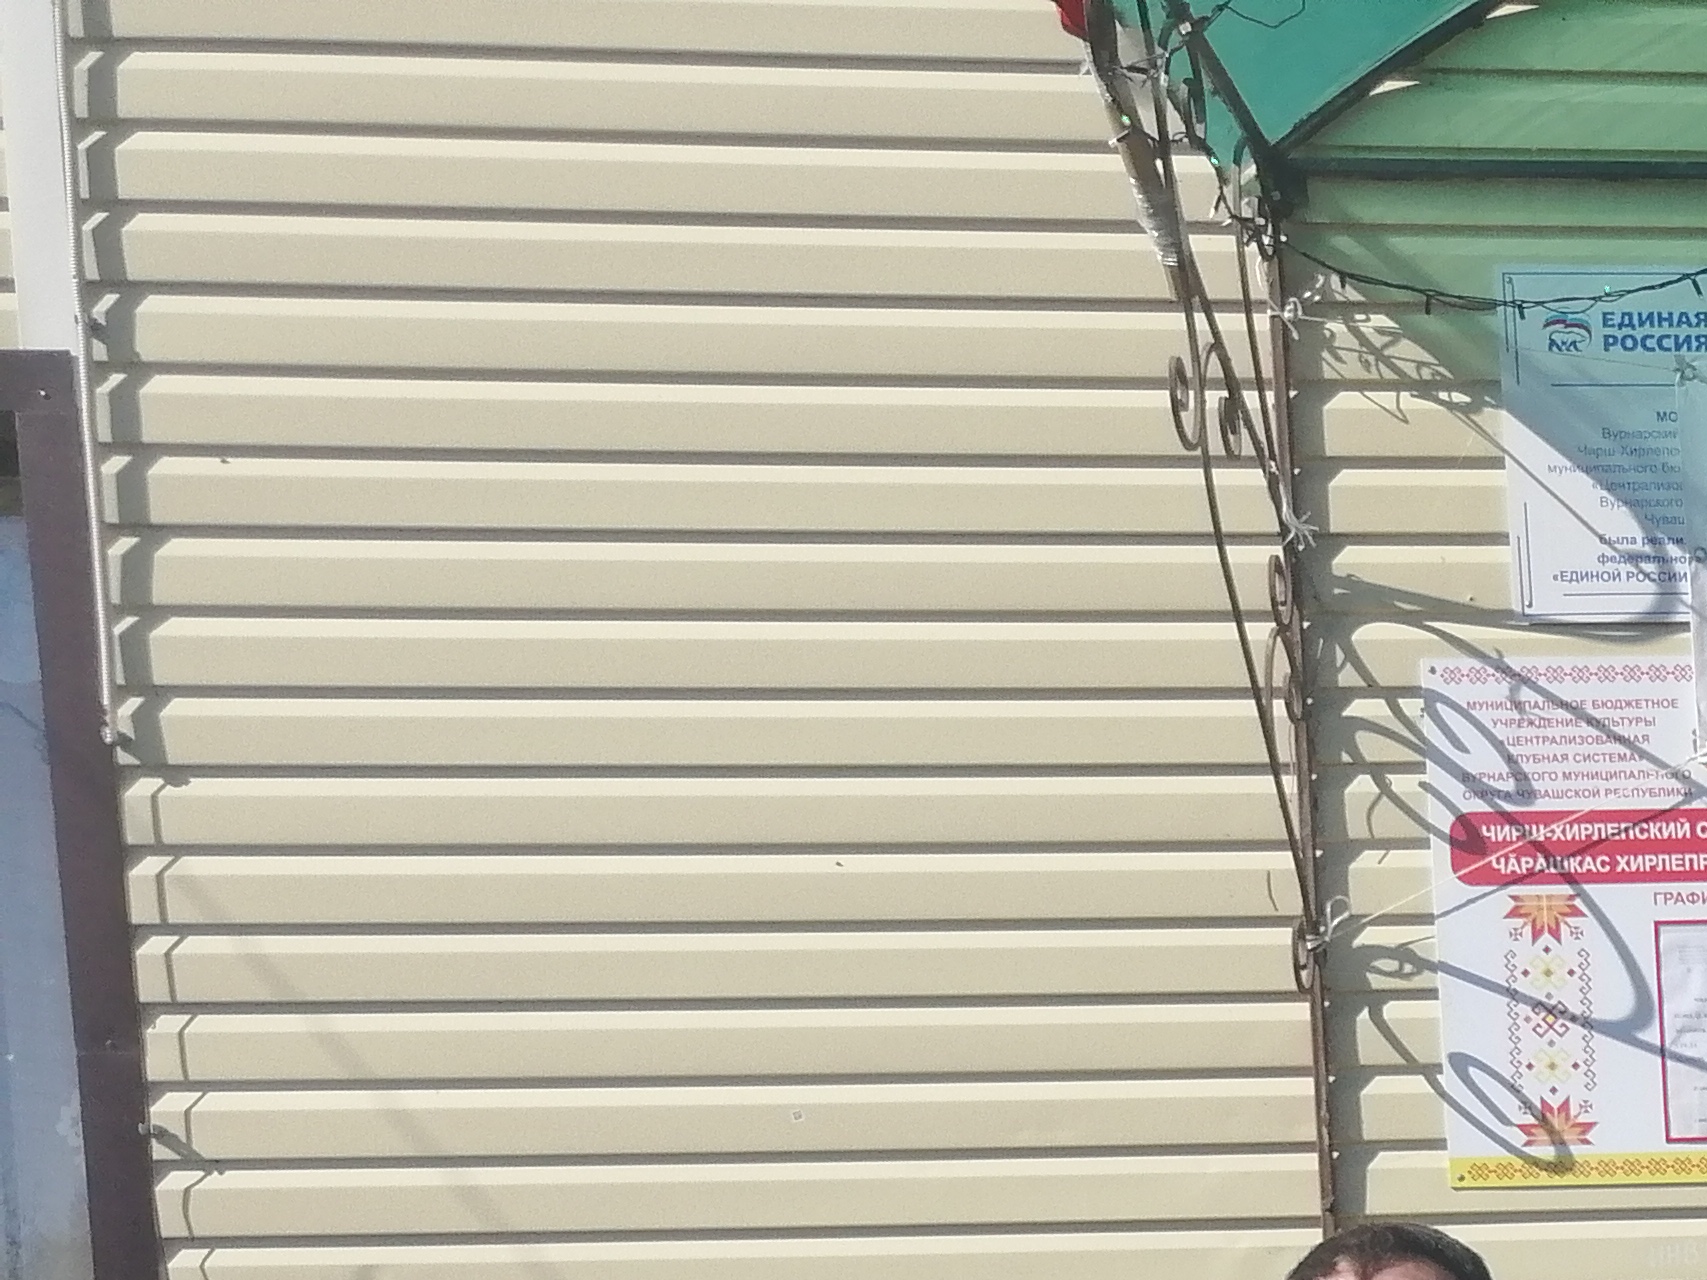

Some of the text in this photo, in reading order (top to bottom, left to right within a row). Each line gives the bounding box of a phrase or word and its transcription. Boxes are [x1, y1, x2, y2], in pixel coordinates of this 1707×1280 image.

[1602, 428, 1678, 441] Вурнарски
[1600, 534, 1637, 546] была
[1626, 570, 1688, 583] РОССИИ
[1466, 698, 1679, 712] МУНИЦИПАЛЬНОЕ БЮДЖЕТНОЕ
[1491, 716, 1656, 729] УЧРЕЖДЕНИЕ КУЛЬТУРЫ
[1507, 752, 1569, 764] КЛУБНАЯ
[1462, 770, 1558, 782] ВУРНАРСКОГО
[1463, 786, 1693, 801] ОКРУГА ЧУВАШСКОЙ РЕСПУБЛИКИ
[1481, 818, 1692, 843] ЧИРШ-ХИРЛЕПСКИЙ
